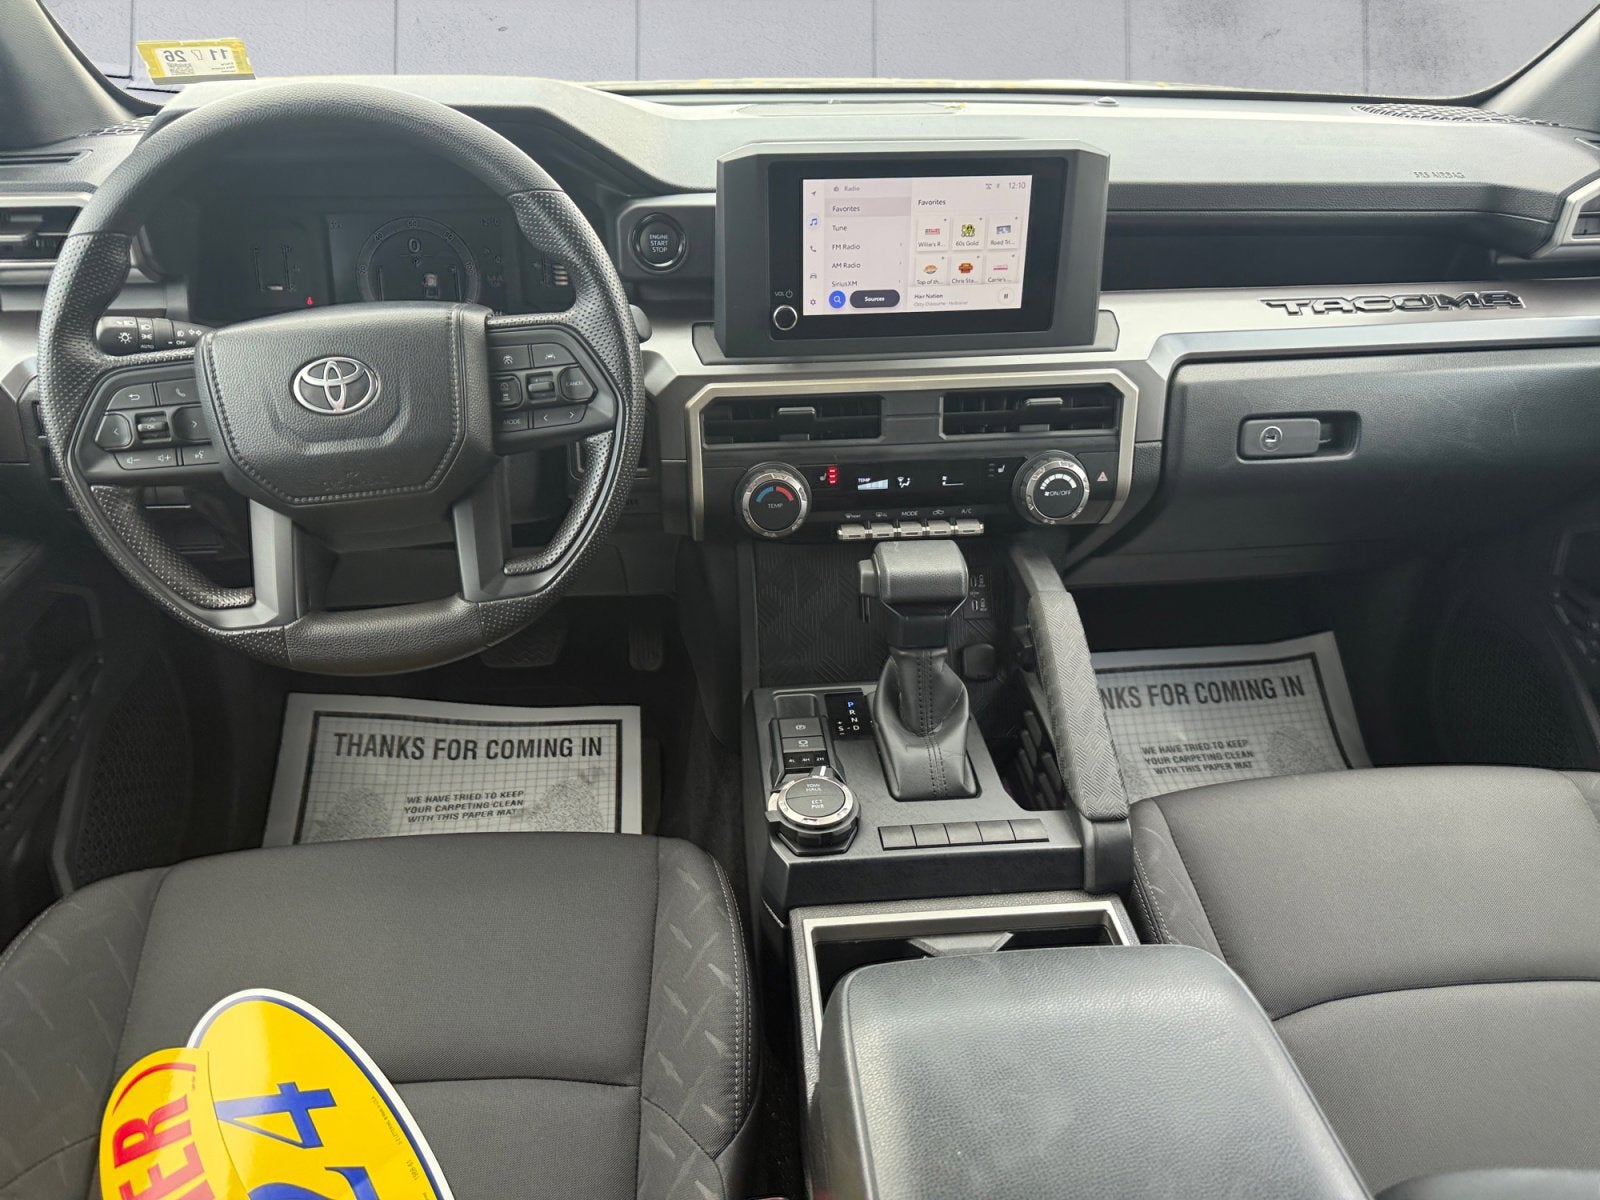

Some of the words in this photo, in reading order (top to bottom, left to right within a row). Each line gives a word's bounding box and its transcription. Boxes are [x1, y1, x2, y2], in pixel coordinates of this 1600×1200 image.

[1008, 182, 1026, 190] 12:10
[832, 205, 861, 214] Favorites
[1260, 290, 1527, 316] TACOMA
[1148, 683, 1190, 707] FOR
[1195, 677, 1277, 704] COMING
[1281, 675, 1305, 697] IN
[334, 732, 425, 760] THANKS
[433, 738, 478, 761] FOR
[486, 737, 573, 760] COMING
[581, 736, 602, 757] IN
[1142, 746, 1157, 755] WE
[1159, 744, 1182, 753] HAVE
[1184, 742, 1210, 752] TRIED
[1212, 741, 1224, 749] TO
[1226, 739, 1249, 748] KEEP
[1145, 756, 1171, 765] YOUR
[1172, 752, 1223, 764] CARPETING
[1225, 750, 1254, 760] CLEAN
[1154, 766, 1178, 775] WITH
[1181, 764, 1202, 773] THIS
[1203, 762, 1233, 771] PAPER
[1233, 761, 1253, 769] MAT
[407, 796, 423, 804] WE
[425, 794, 450, 803] HAVE
[454, 792, 482, 801] TRIED
[485, 792, 497, 800] TO
[500, 790, 524, 798] KEEP
[404, 805, 432, 814] YOUR
[435, 802, 490, 812] CARPETING
[493, 799, 524, 808] CLEAN
[408, 814, 434, 823] WITH
[437, 813, 459, 821] THIS
[462, 810, 493, 819] PAPER
[112, 1094, 215, 1200] ER
